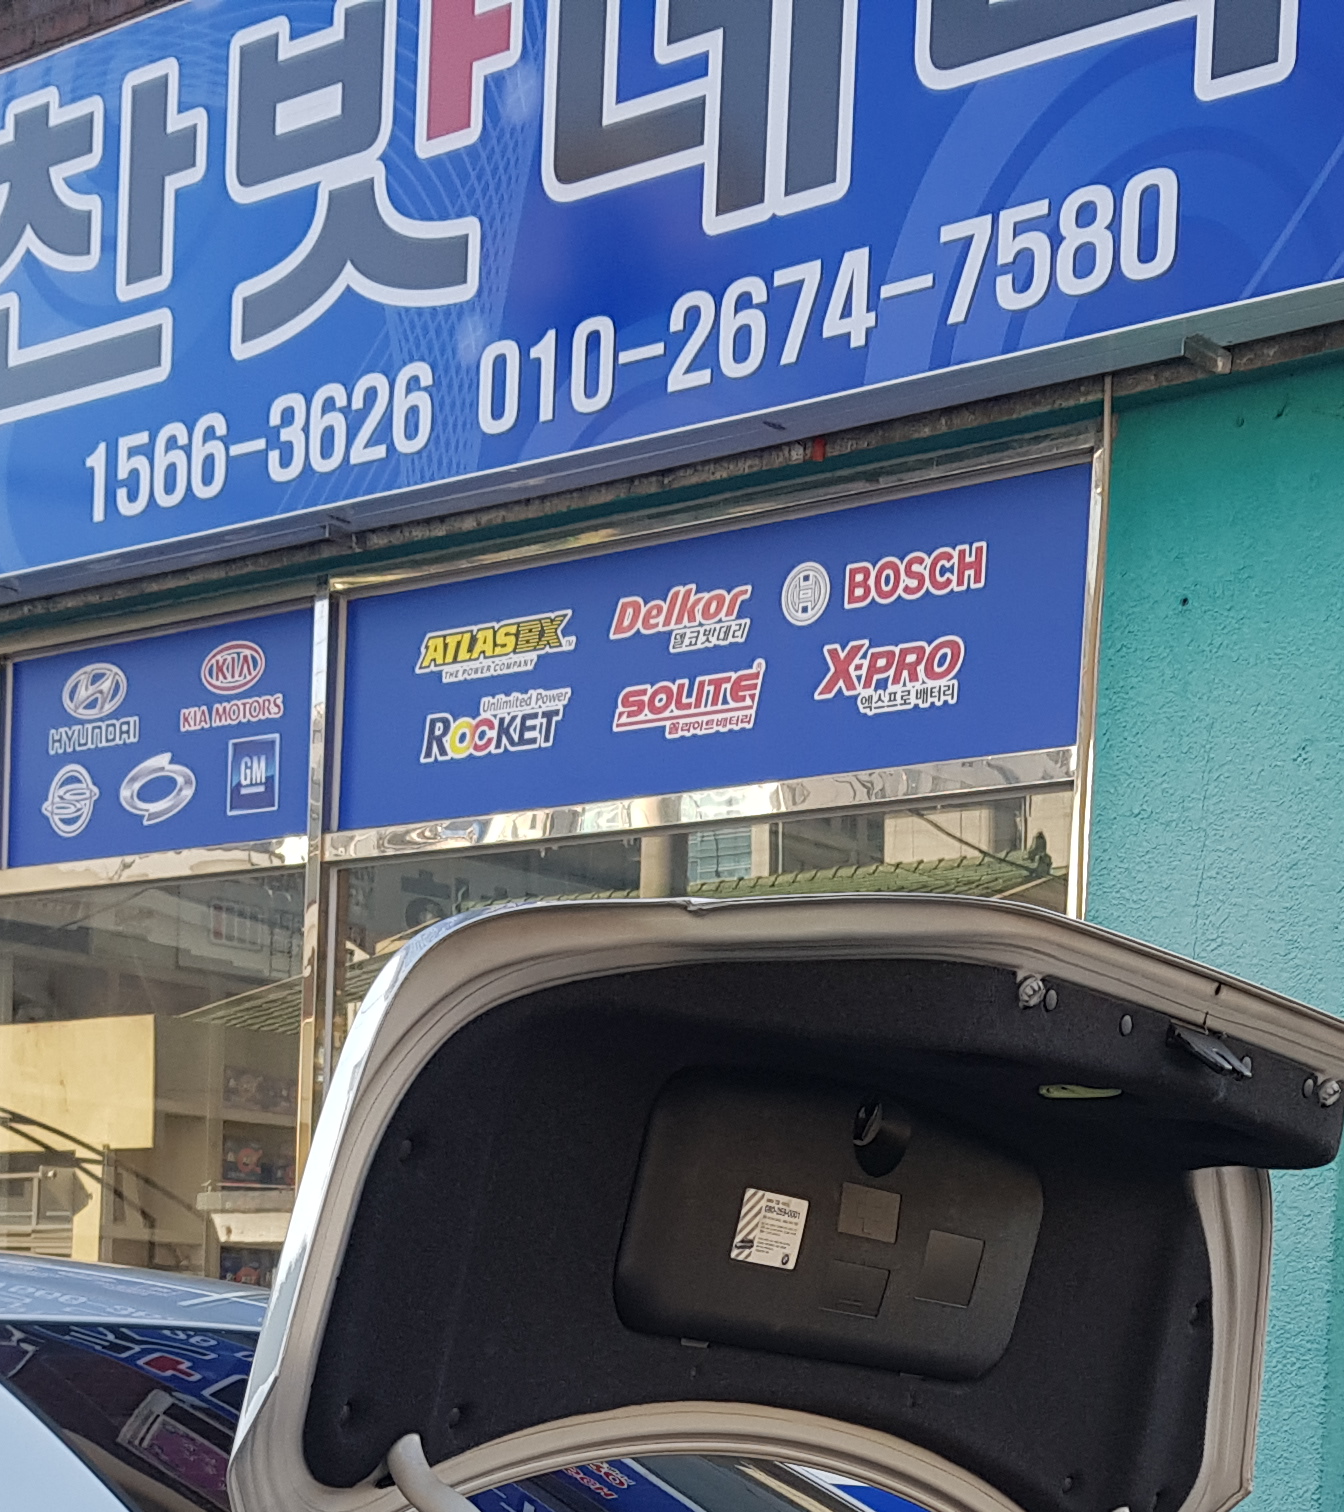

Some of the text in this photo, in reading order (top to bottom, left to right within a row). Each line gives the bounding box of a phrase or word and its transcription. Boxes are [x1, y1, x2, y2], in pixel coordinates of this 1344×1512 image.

[83, 167, 1180, 523] 1566-3626 010-2674-7580
[845, 543, 986, 607] BOSCH
[611, 586, 751, 637] Delkor
[417, 612, 570, 670] ATLASBX
[213, 655, 255, 683] KIA
[443, 658, 536, 681] THE POWER COMPANY
[180, 694, 285, 732] KIA MOTORS
[481, 690, 570, 713] Unlimited Power
[619, 670, 761, 720] SOLITE
[859, 682, 956, 712] 엑스프로 배터리
[48, 716, 140, 755] HYUNDAI
[422, 707, 561, 761] ROCKET
[239, 755, 267, 786] GM
